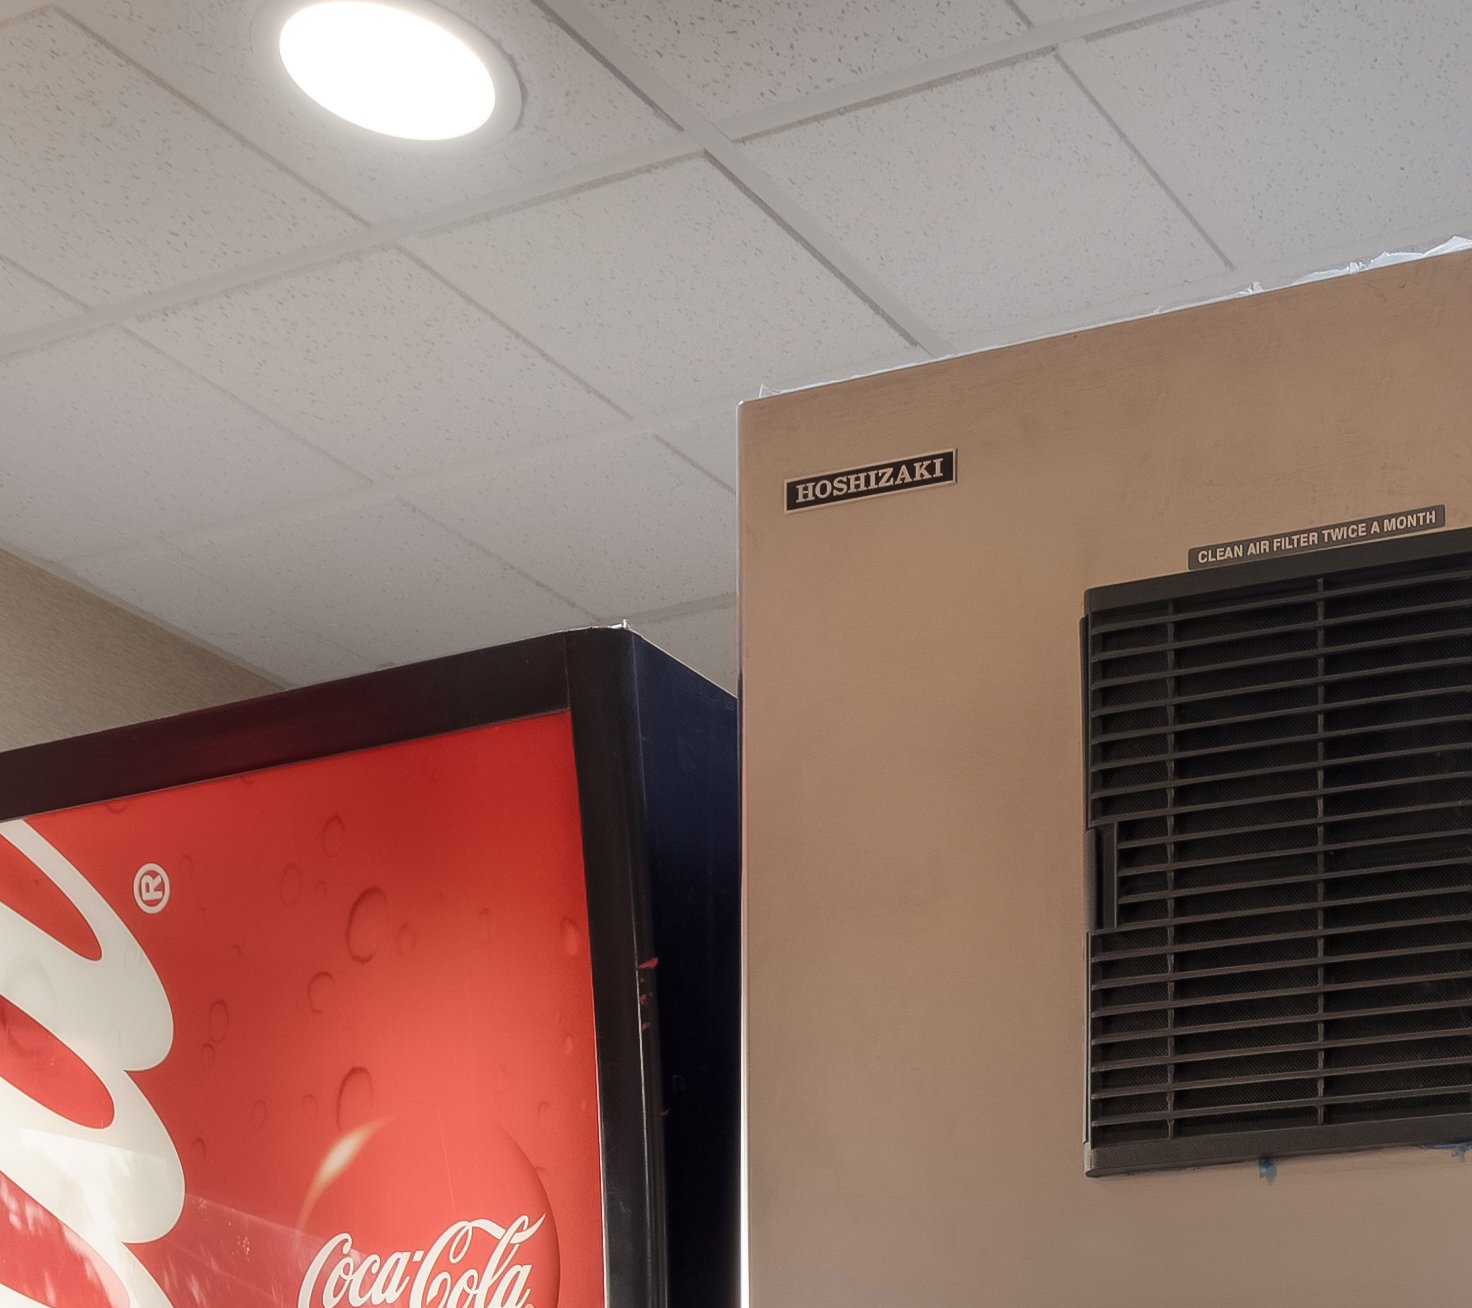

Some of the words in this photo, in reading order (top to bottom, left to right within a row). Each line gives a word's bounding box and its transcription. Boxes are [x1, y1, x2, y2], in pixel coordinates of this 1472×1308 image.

[795, 458, 944, 504] HOSHIZAKI
[1197, 544, 1244, 565] CLEAN
[1247, 538, 1270, 558] AIR
[1273, 531, 1319, 555] FILTER
[1322, 523, 1367, 546] TWICE
[1370, 521, 1381, 536] A
[1383, 509, 1437, 534] MONTH
